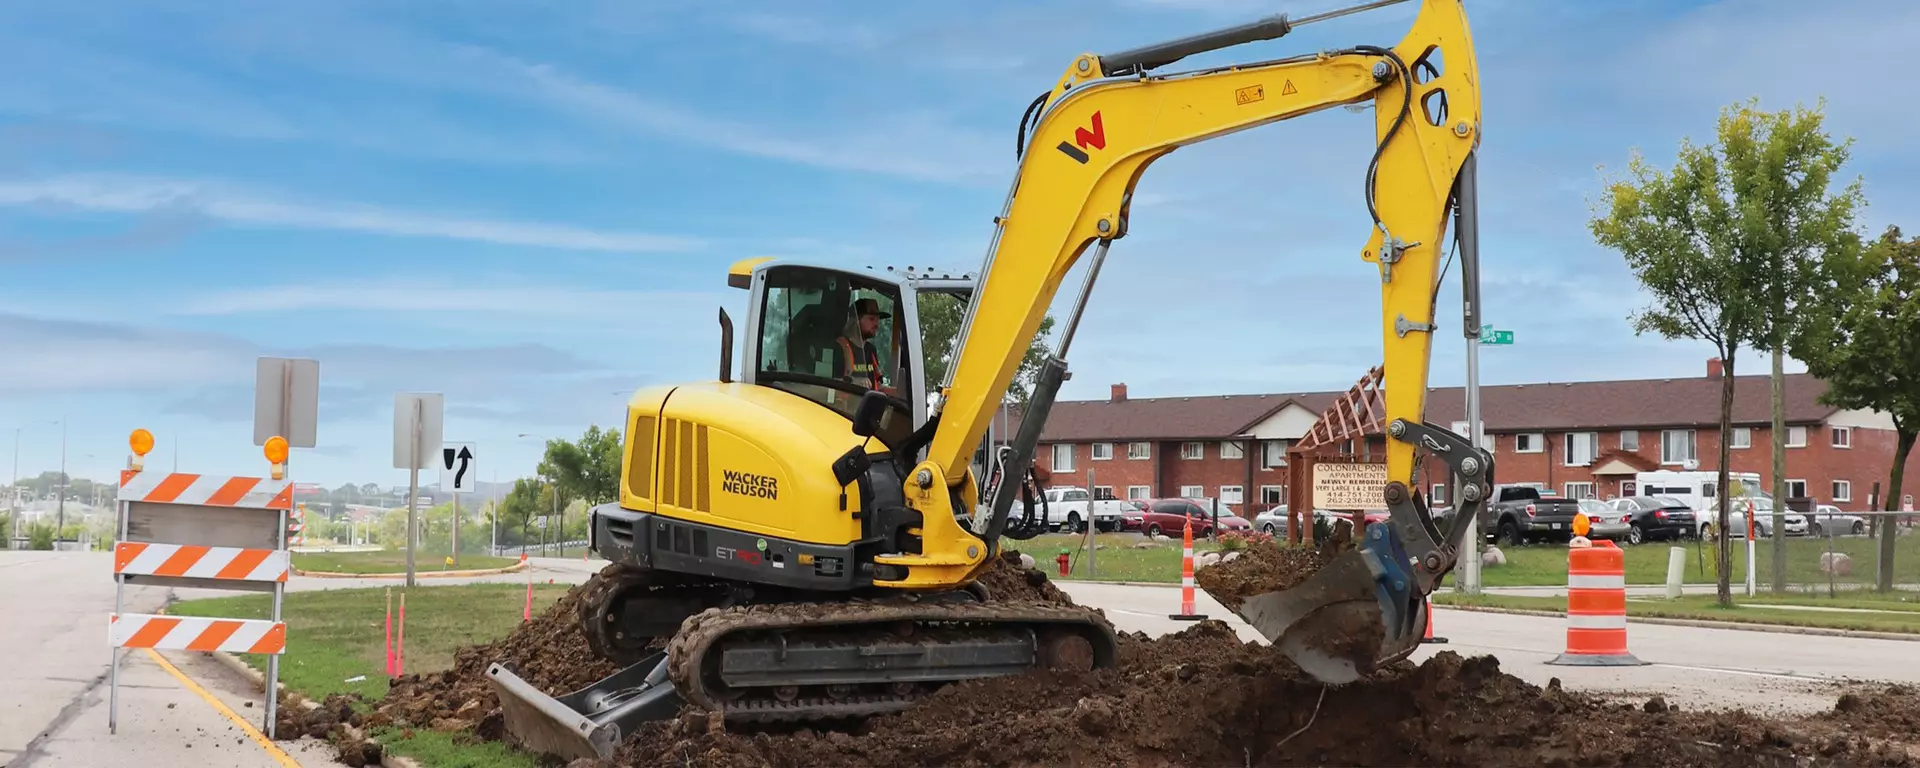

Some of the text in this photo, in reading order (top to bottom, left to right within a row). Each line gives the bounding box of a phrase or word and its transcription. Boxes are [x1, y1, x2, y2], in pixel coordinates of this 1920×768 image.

[1317, 464, 1386, 472] COLONIAL POIN
[723, 469, 778, 489] WACKER
[723, 480, 778, 500] NEUSON
